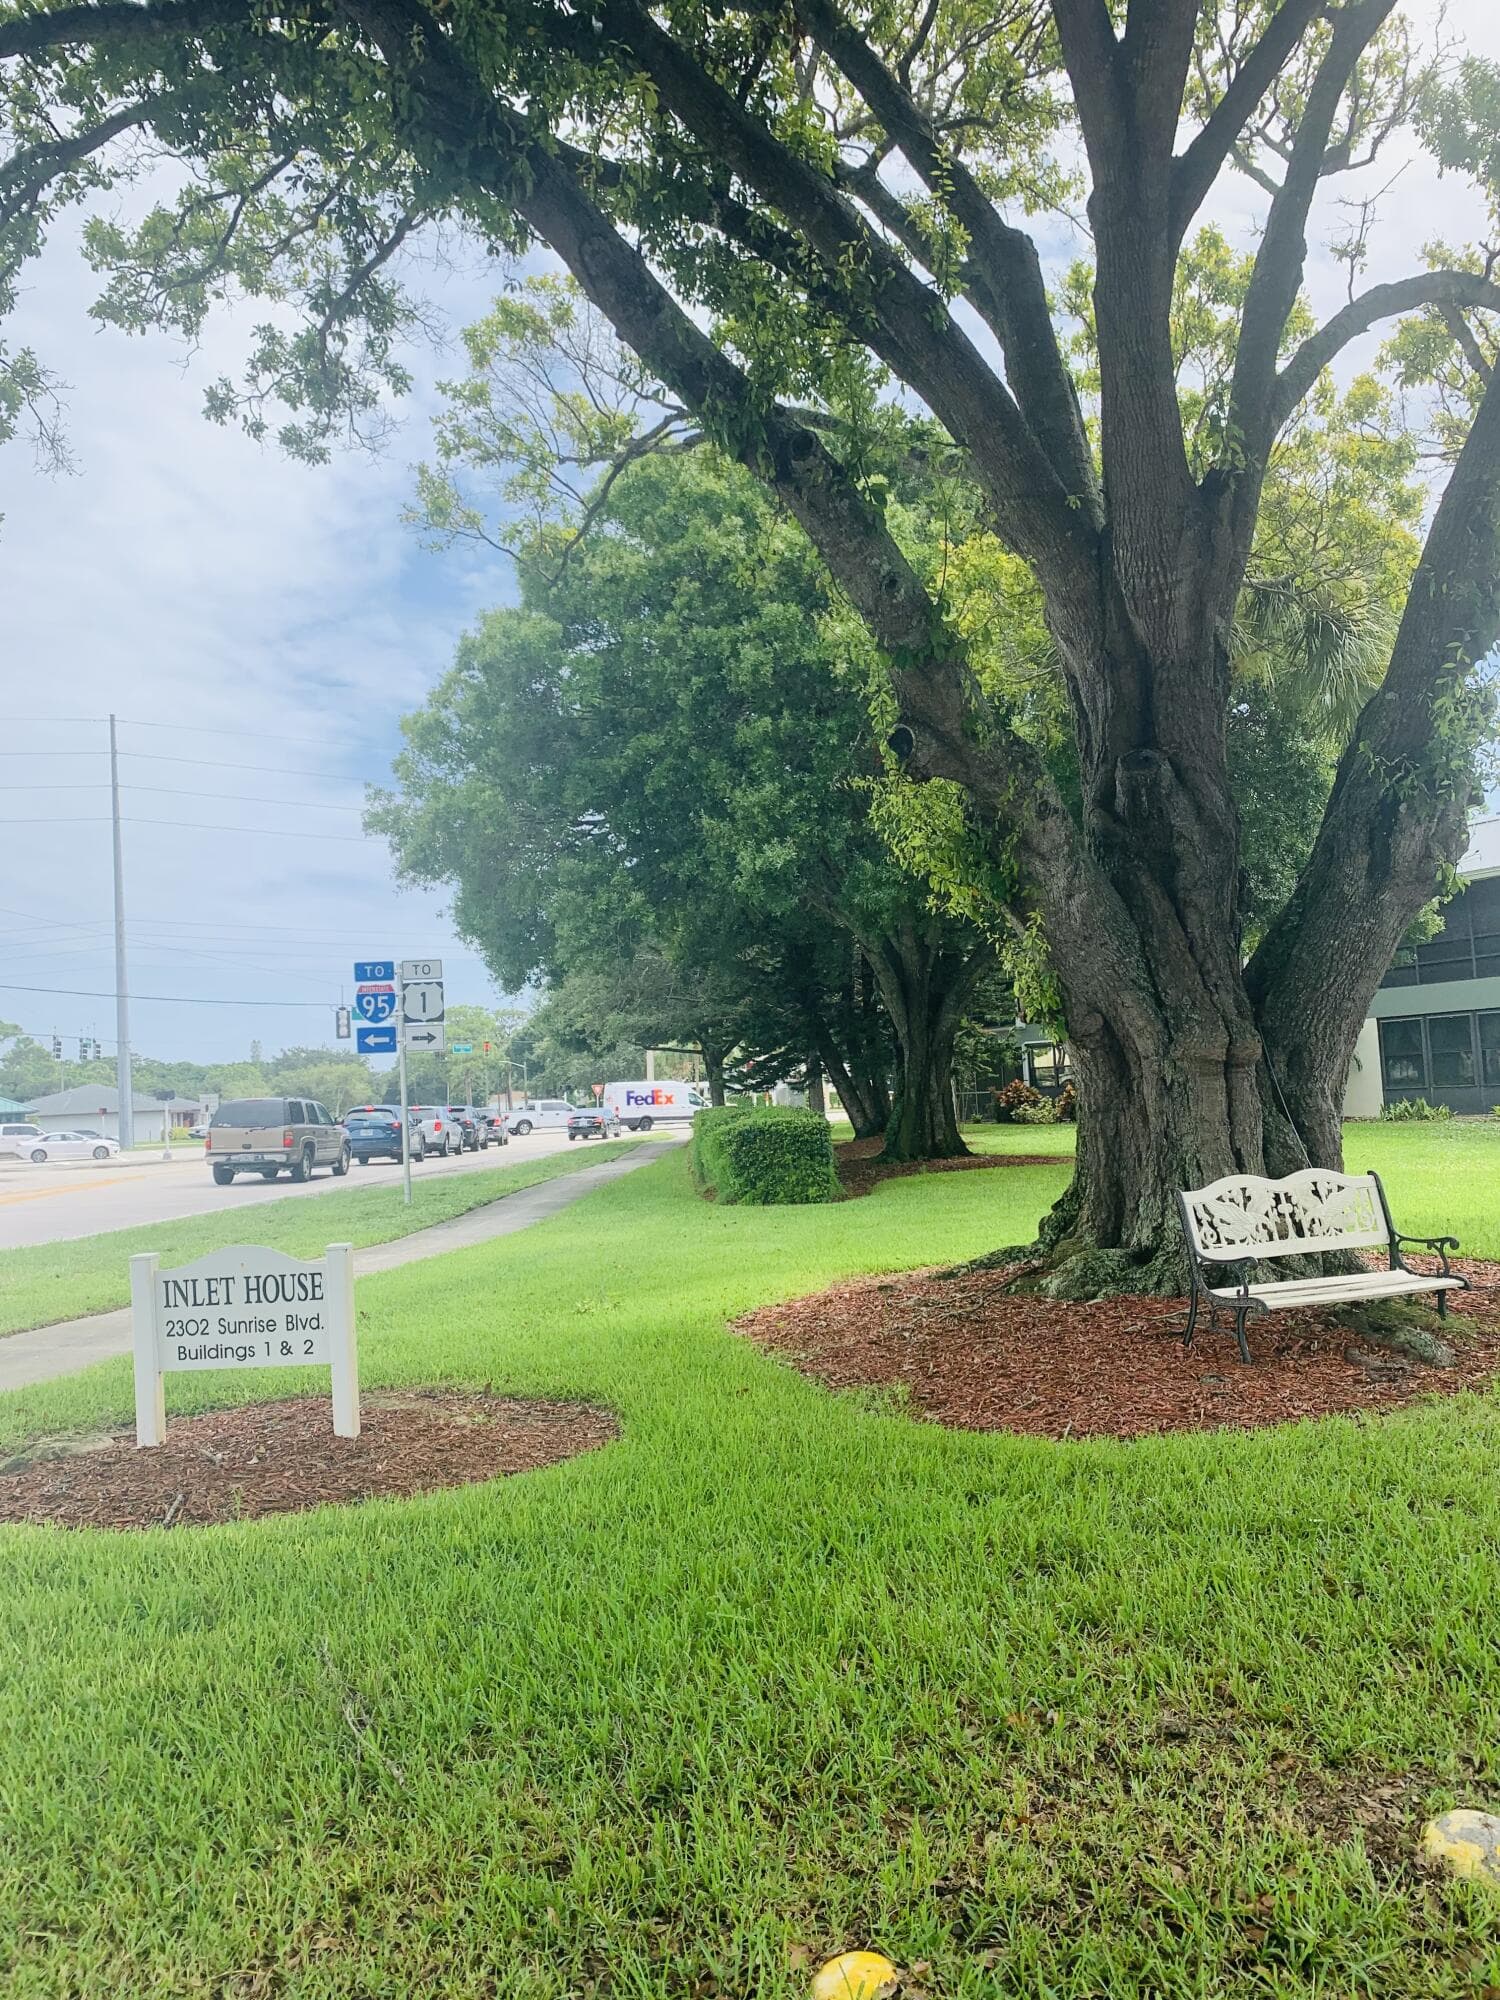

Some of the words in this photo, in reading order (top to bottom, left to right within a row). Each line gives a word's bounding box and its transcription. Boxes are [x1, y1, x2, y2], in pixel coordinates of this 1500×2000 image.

[364, 965, 385, 978] TO
[412, 964, 431, 976] TO
[362, 995, 390, 1018] 95
[420, 991, 427, 1013] 1
[626, 1088, 674, 1106] FedEx
[162, 1276, 235, 1308] INLET
[243, 1272, 324, 1304] HOUSE
[165, 1318, 210, 1337] 2302
[218, 1316, 277, 1335] Sunrise
[286, 1313, 324, 1332] Blvd.
[177, 1343, 256, 1361] Buildings
[264, 1341, 271, 1356] 1
[280, 1340, 293, 1356] &
[303, 1339, 314, 1355] 2
